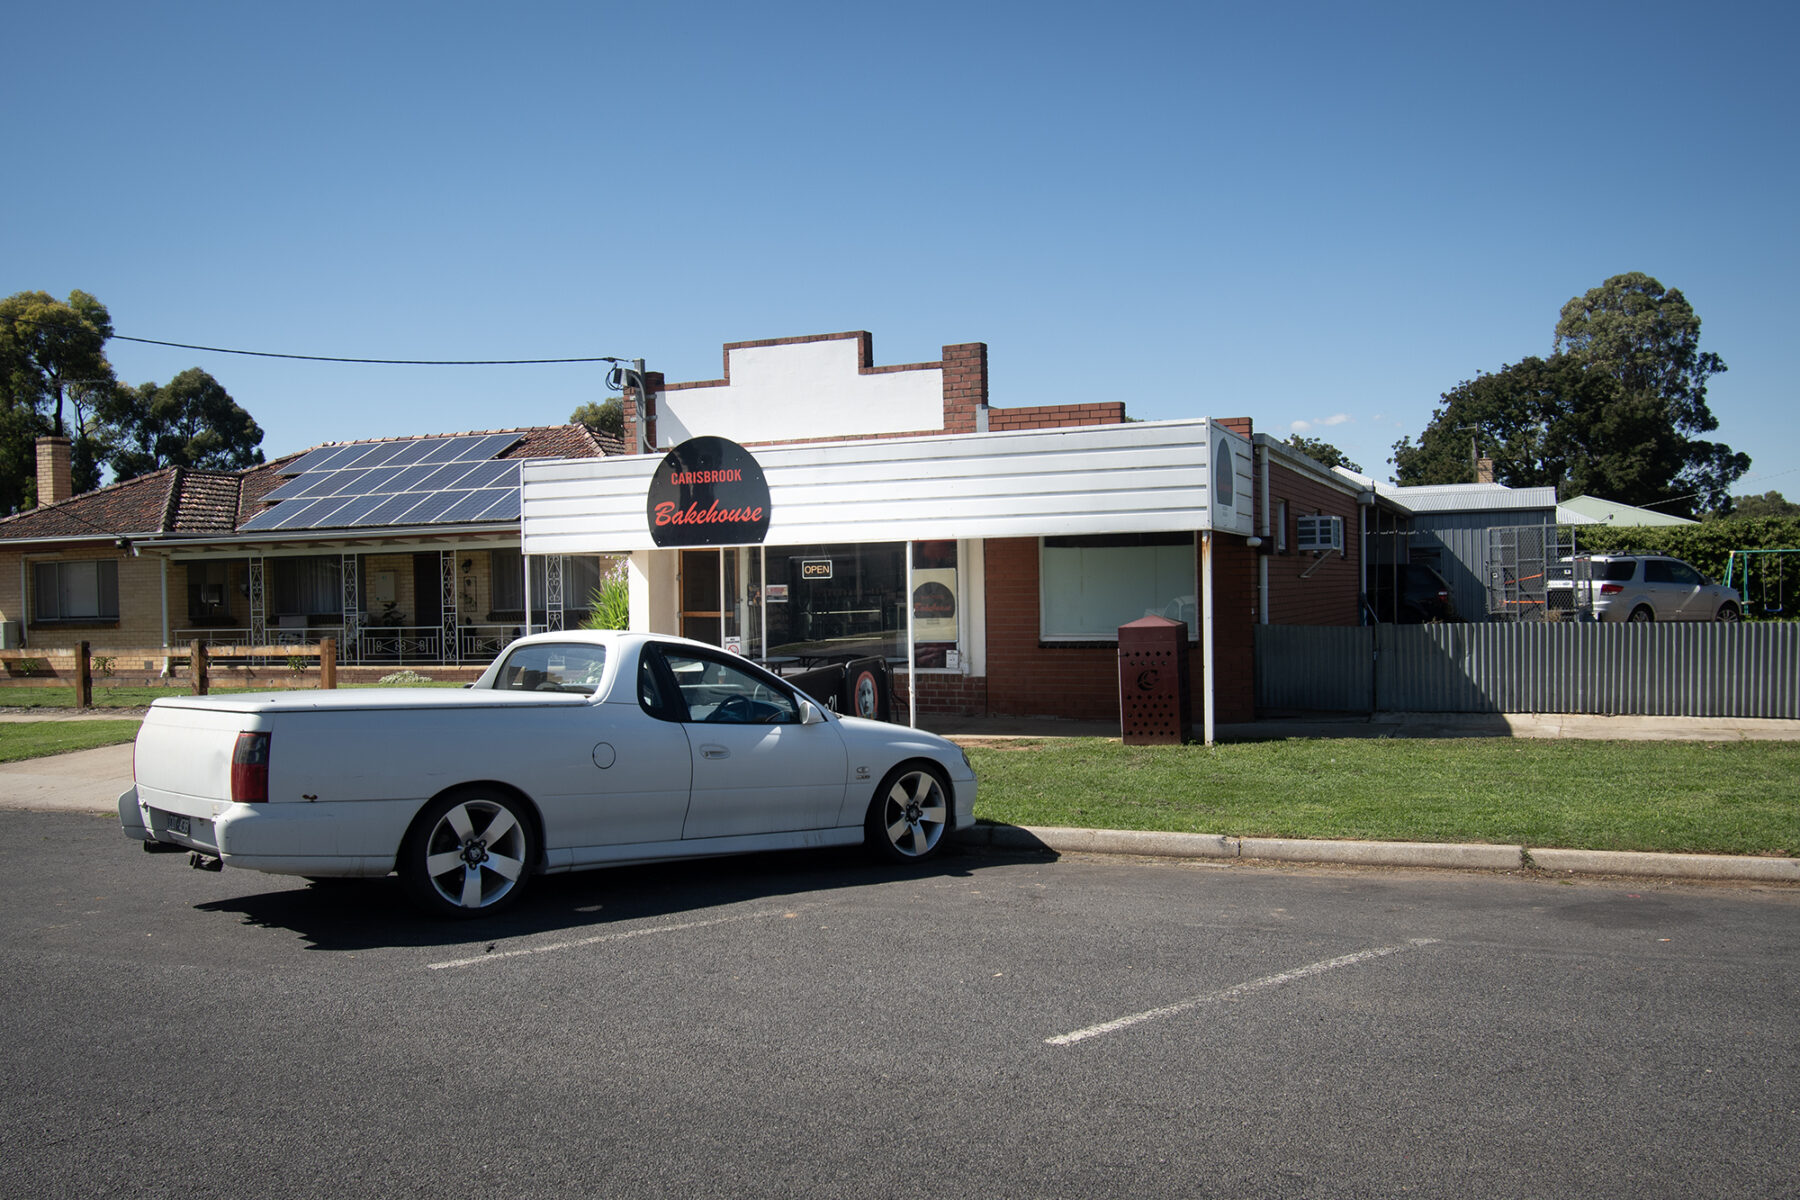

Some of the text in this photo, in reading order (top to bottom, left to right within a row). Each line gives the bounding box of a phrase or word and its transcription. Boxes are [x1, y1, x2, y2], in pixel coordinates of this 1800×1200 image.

[671, 469, 742, 485] CARISBROOK
[654, 499, 763, 526] Bakehouse
[804, 565, 830, 575] OPEN
